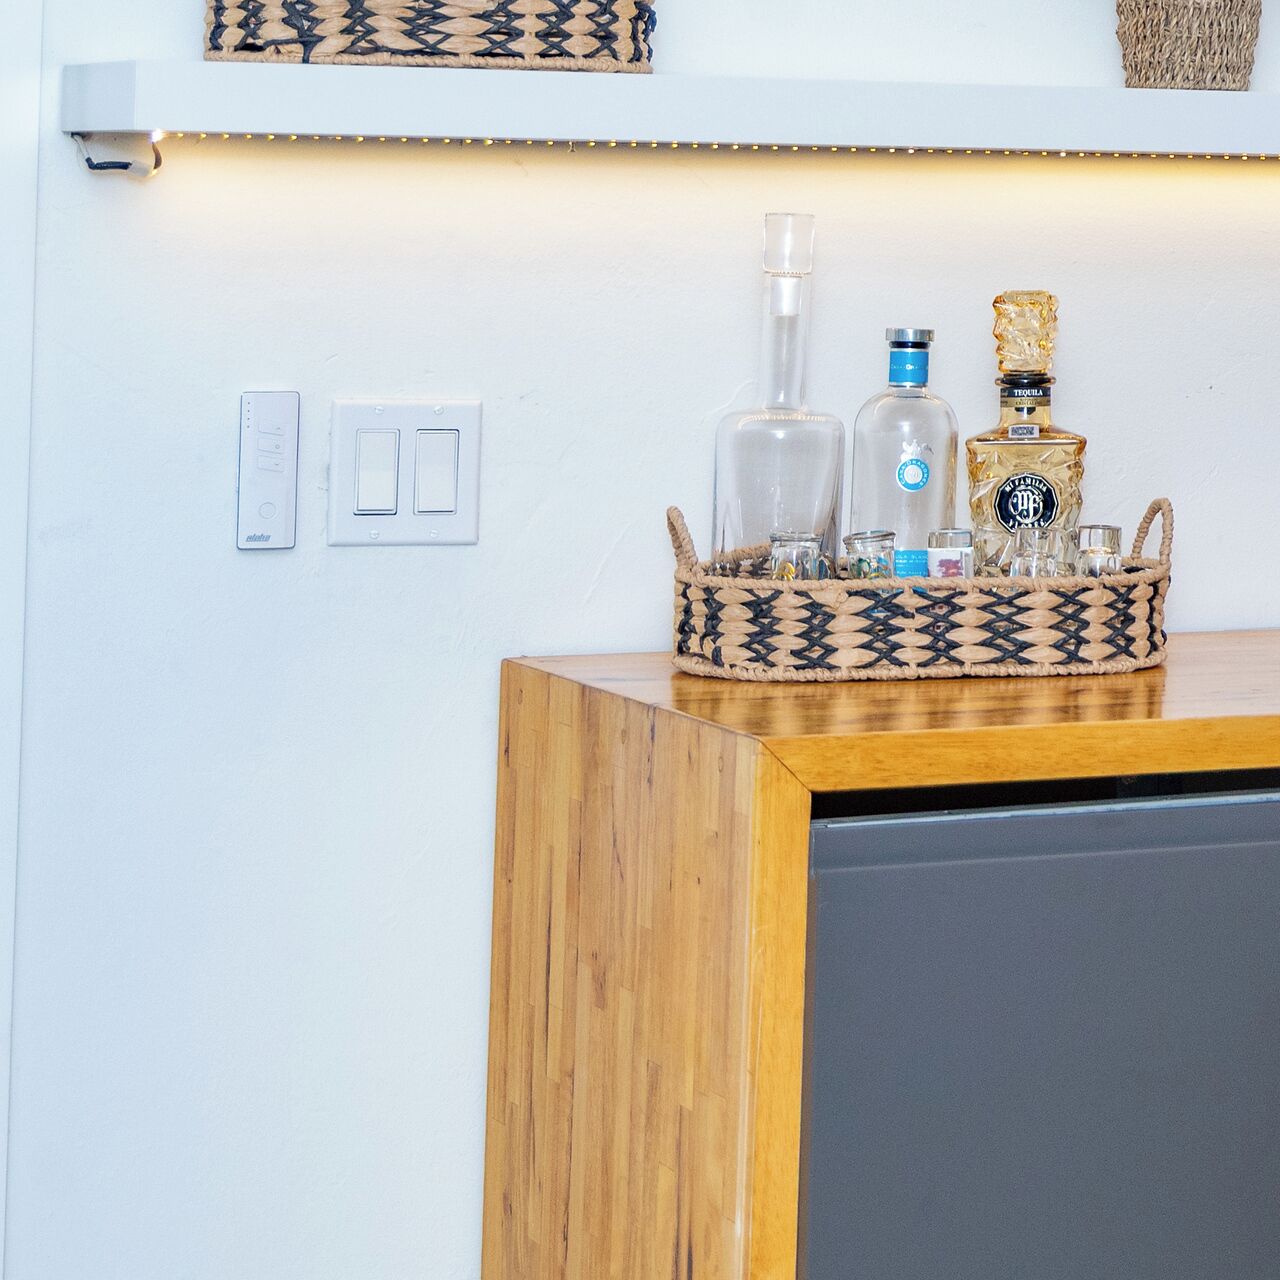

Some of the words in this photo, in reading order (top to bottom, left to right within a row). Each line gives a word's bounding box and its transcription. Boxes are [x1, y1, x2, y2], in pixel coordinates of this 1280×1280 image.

[1014, 389, 1043, 397] TEQUILA
[1005, 481, 1013, 492] MI
[1014, 477, 1048, 492] FAMILIA
